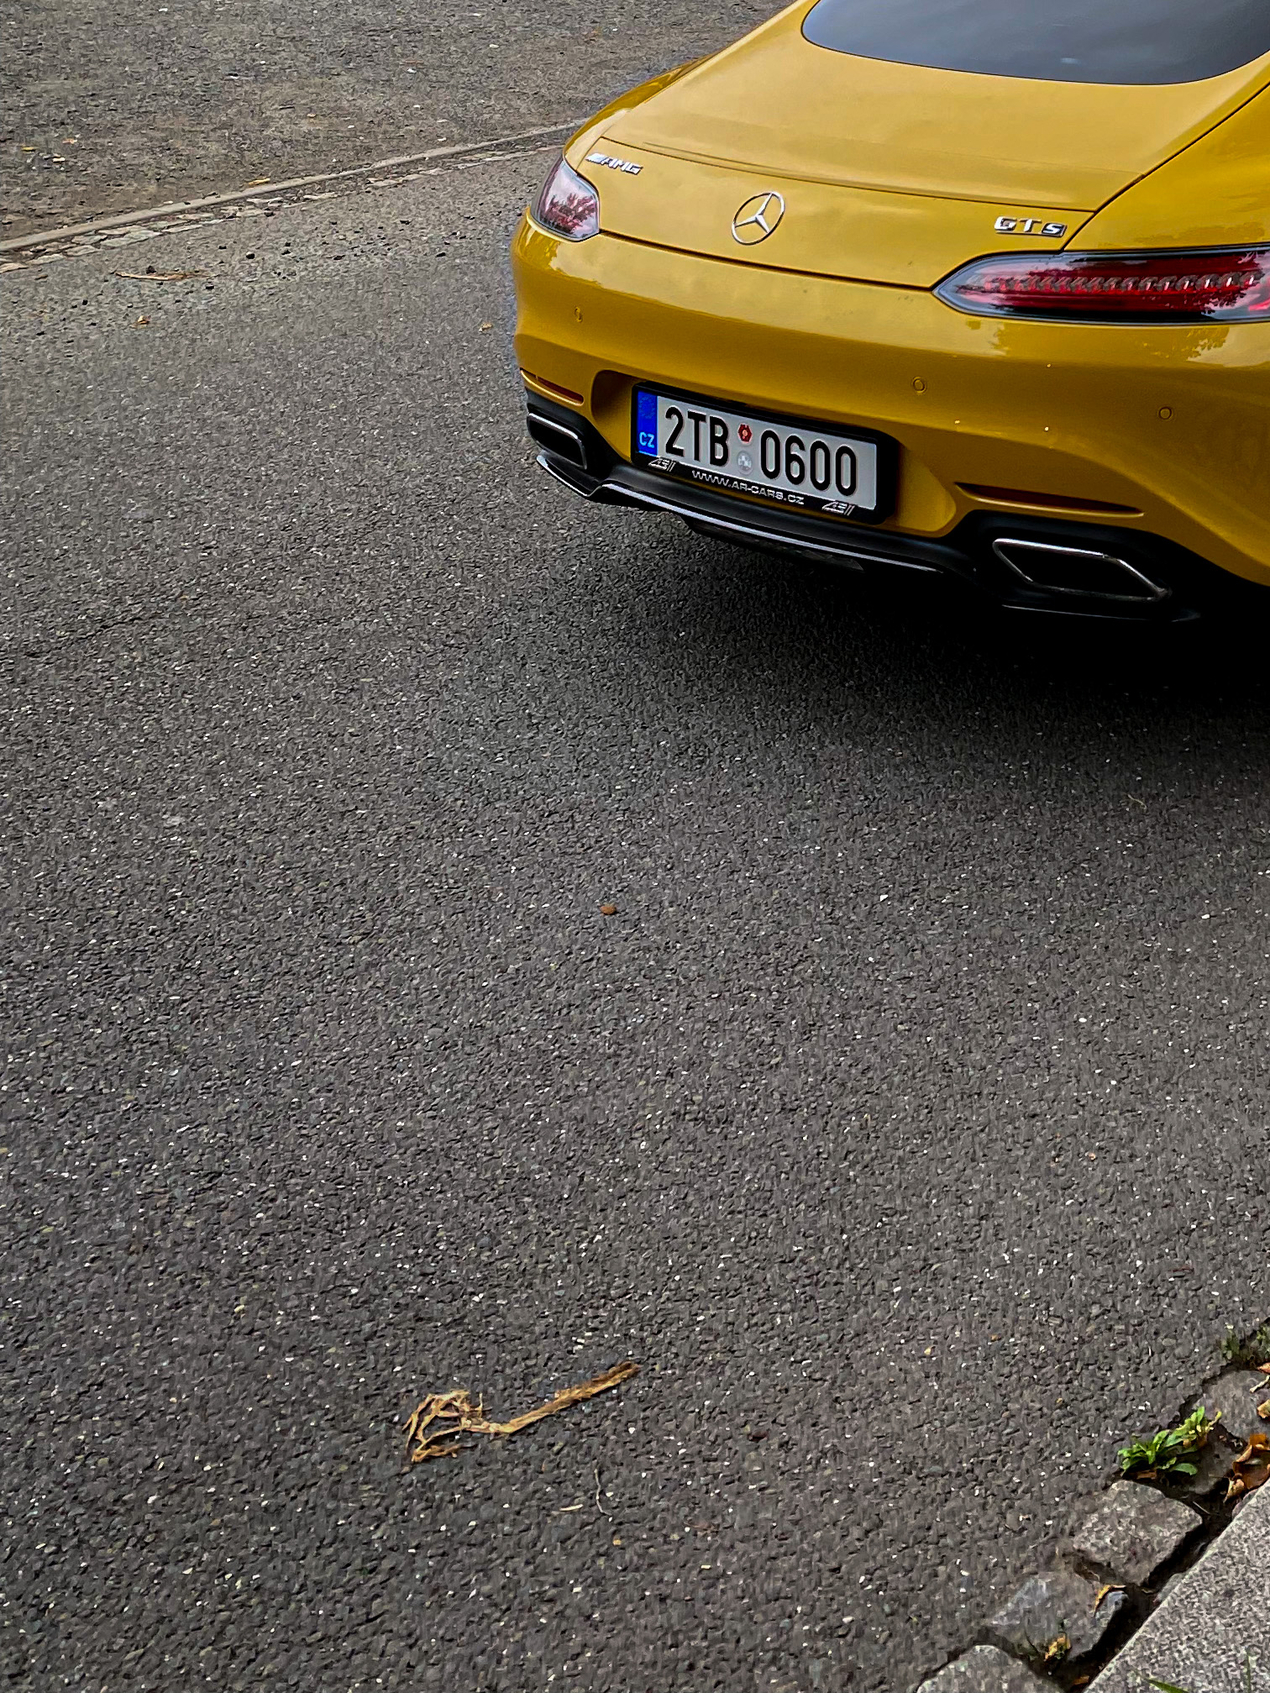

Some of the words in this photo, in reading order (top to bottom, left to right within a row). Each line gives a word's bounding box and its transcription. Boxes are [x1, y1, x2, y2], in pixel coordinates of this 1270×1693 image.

[600, 156, 643, 175] AMG
[639, 431, 656, 449] CZ
[665, 406, 729, 467] 2TB
[760, 429, 857, 497] 0600
[691, 469, 805, 506] WWW.AR-CARS.CZ
